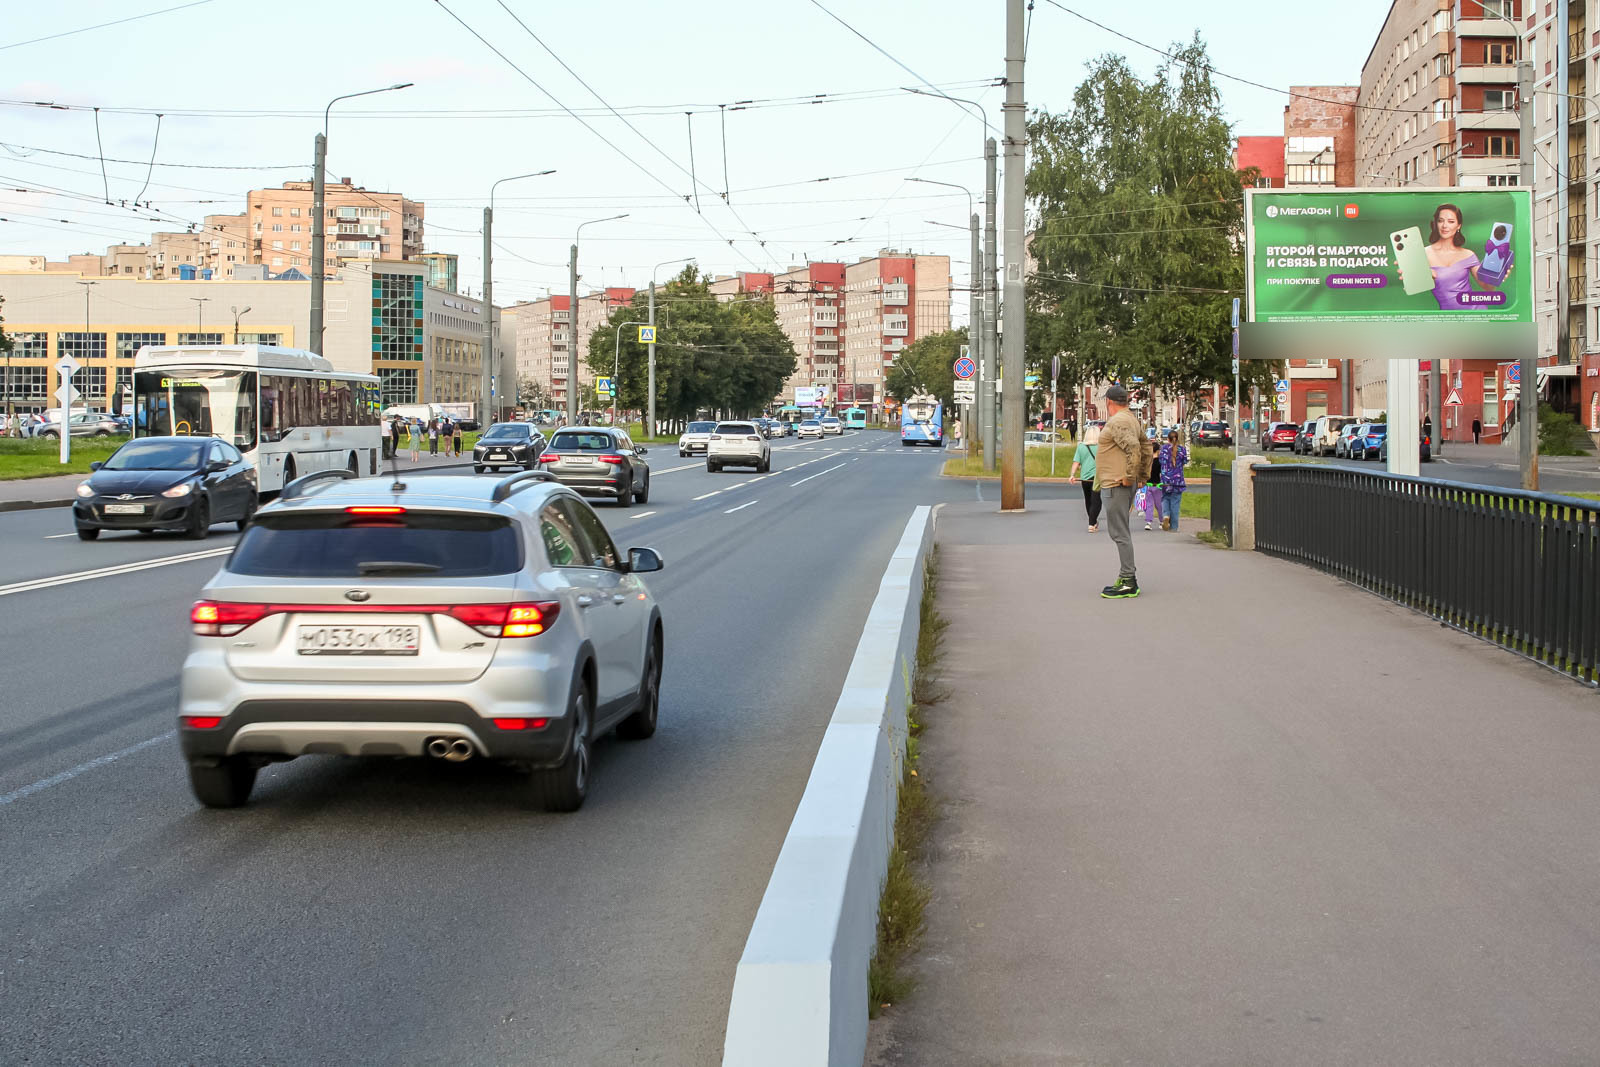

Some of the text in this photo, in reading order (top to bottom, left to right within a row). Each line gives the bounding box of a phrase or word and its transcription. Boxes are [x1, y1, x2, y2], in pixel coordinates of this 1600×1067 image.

[1266, 245, 1387, 256] ВТОРОЙ СМАРТФОН
[1266, 257, 1388, 268] И СВЯЗЬ В ПОДАРОК
[1332, 277, 1381, 285] REDMI NOTE 13
[299, 628, 416, 647] М053ОК 198
